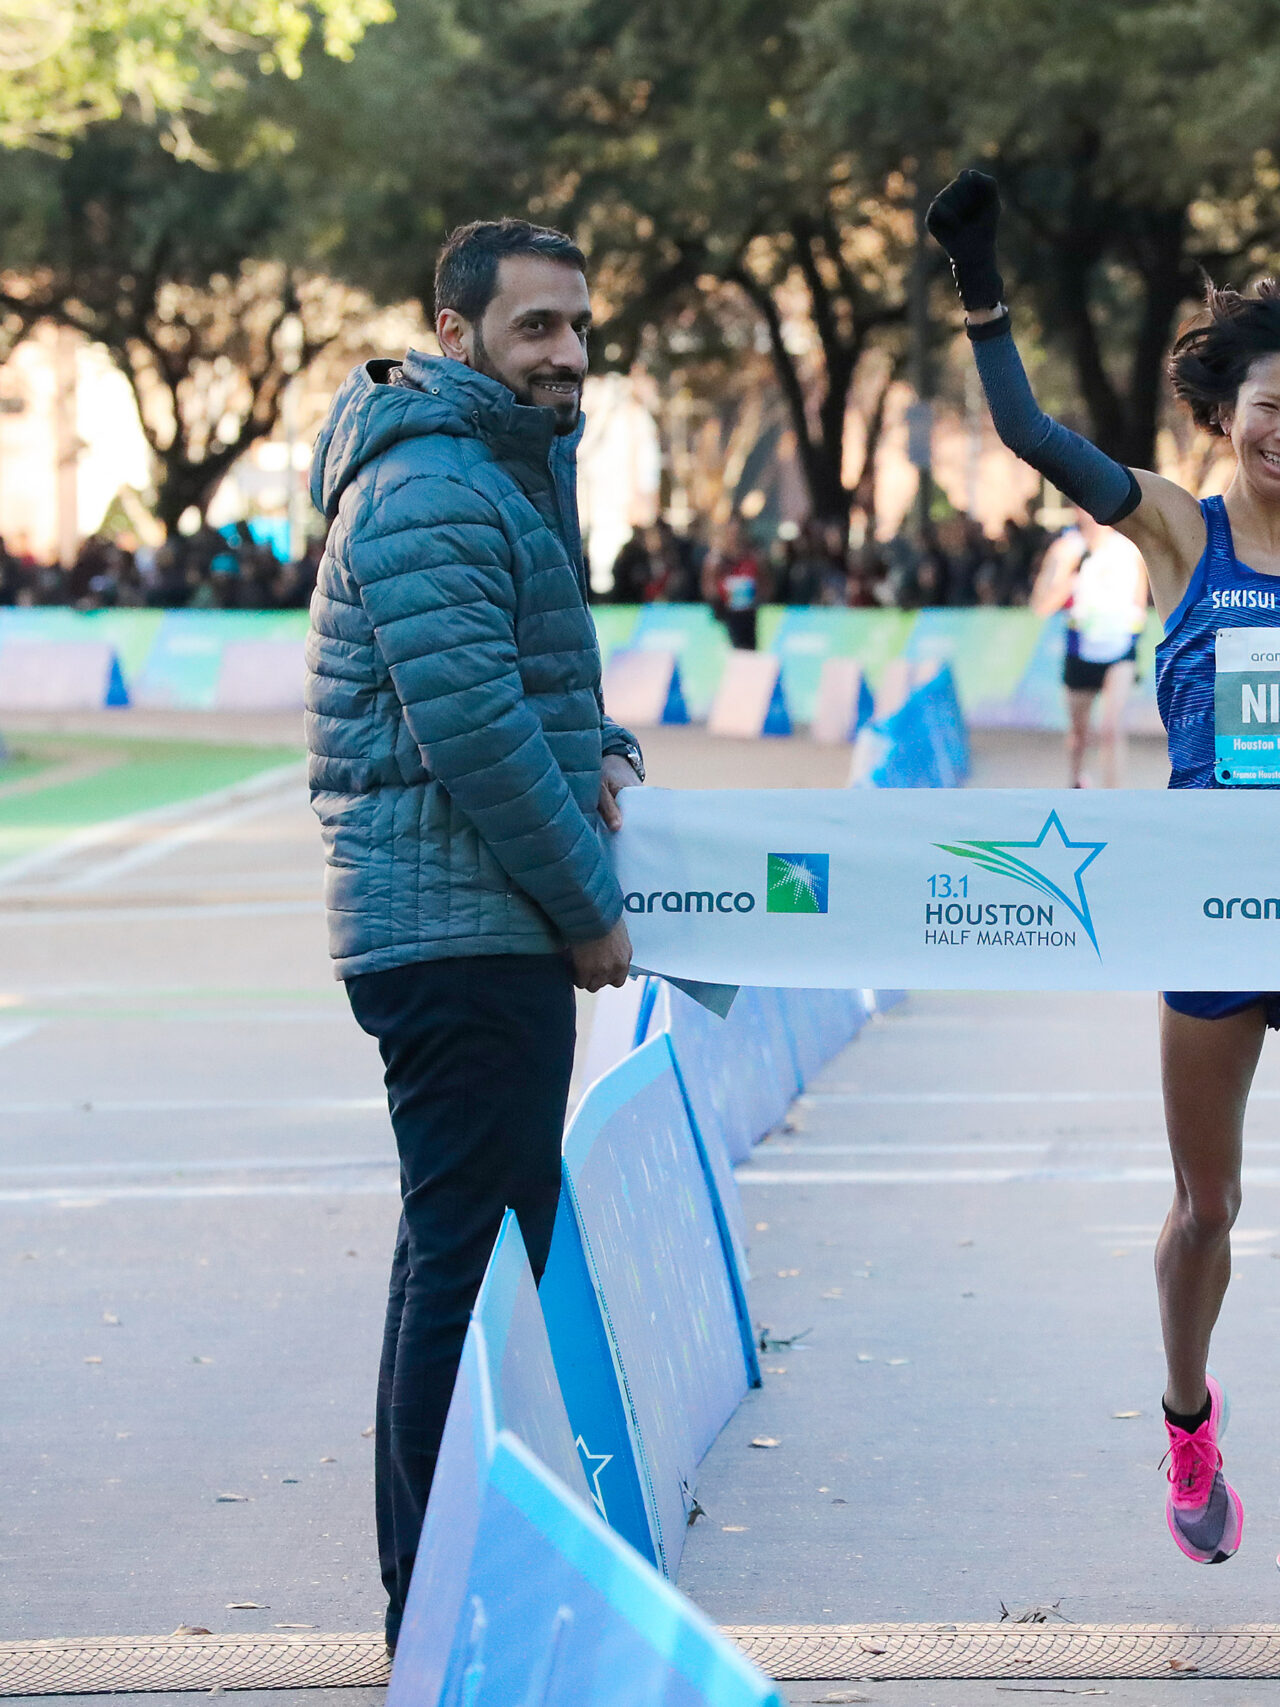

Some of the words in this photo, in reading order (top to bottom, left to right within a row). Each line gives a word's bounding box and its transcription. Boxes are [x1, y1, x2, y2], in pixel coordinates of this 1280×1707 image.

[1212, 590, 1275, 609] SEKISUI
[1233, 738, 1274, 751] Houston
[926, 874, 968, 898] 13.1
[624, 891, 755, 913] aramco
[926, 903, 1053, 926] HOUSTON
[925, 930, 971, 945] HALF
[976, 930, 1076, 947] MARATHON
